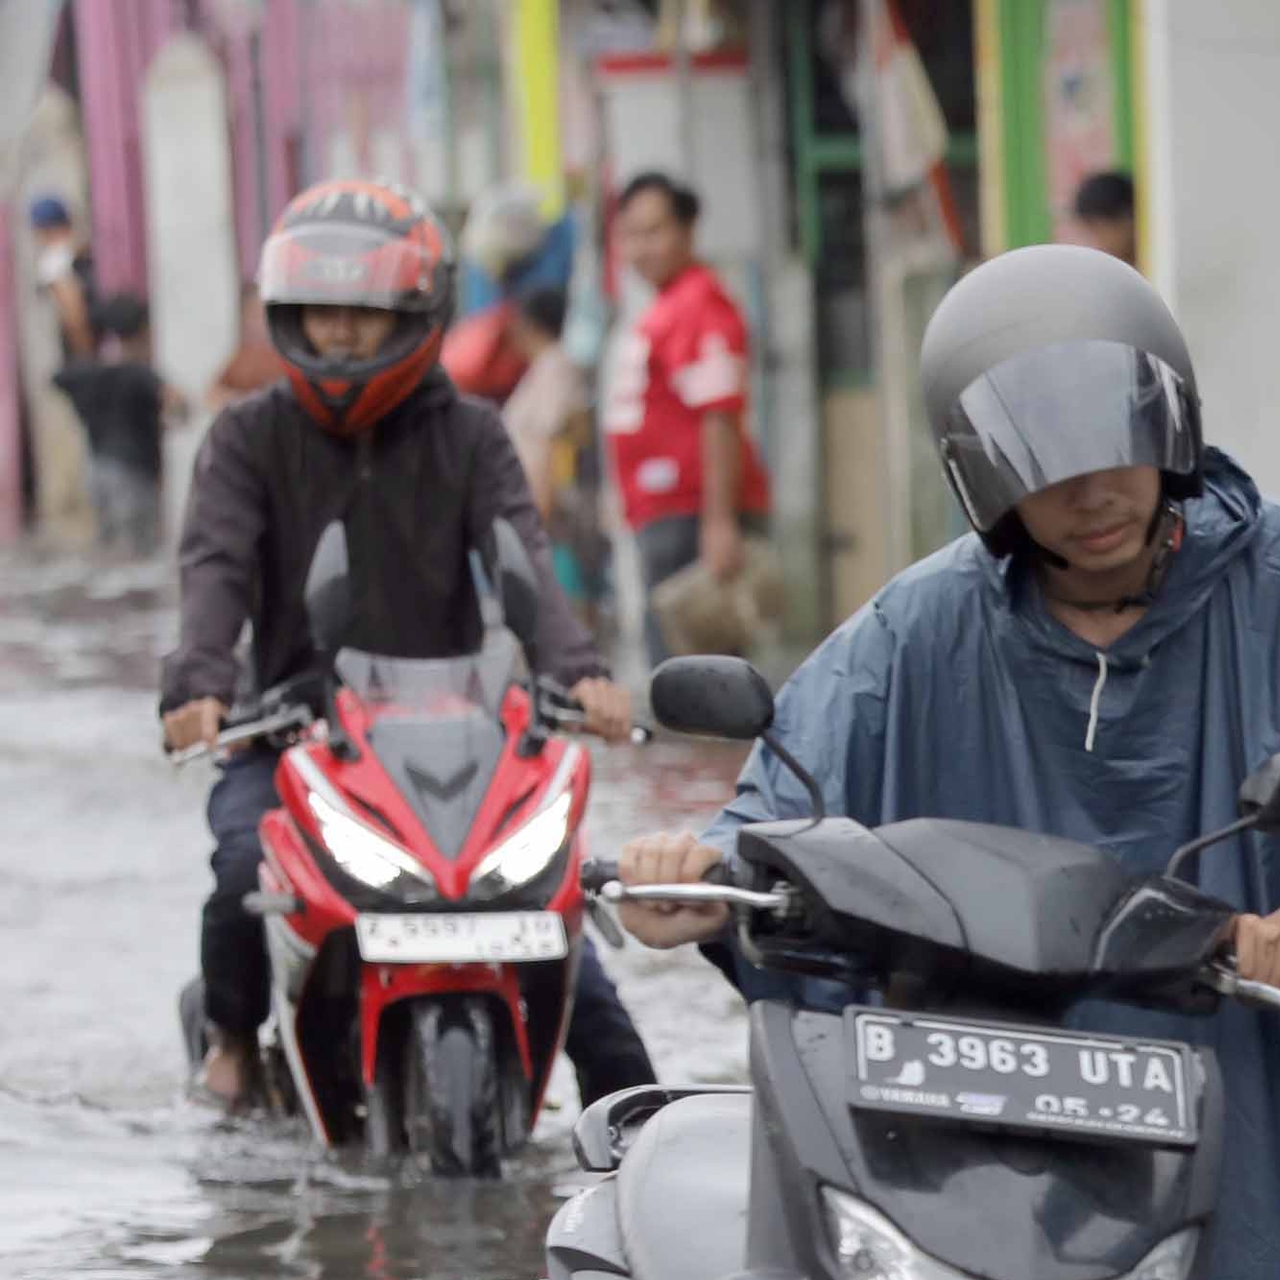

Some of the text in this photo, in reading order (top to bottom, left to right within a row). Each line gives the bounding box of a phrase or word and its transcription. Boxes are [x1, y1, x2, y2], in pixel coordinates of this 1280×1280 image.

[866, 1025, 1174, 1093] B 3963 UTA
